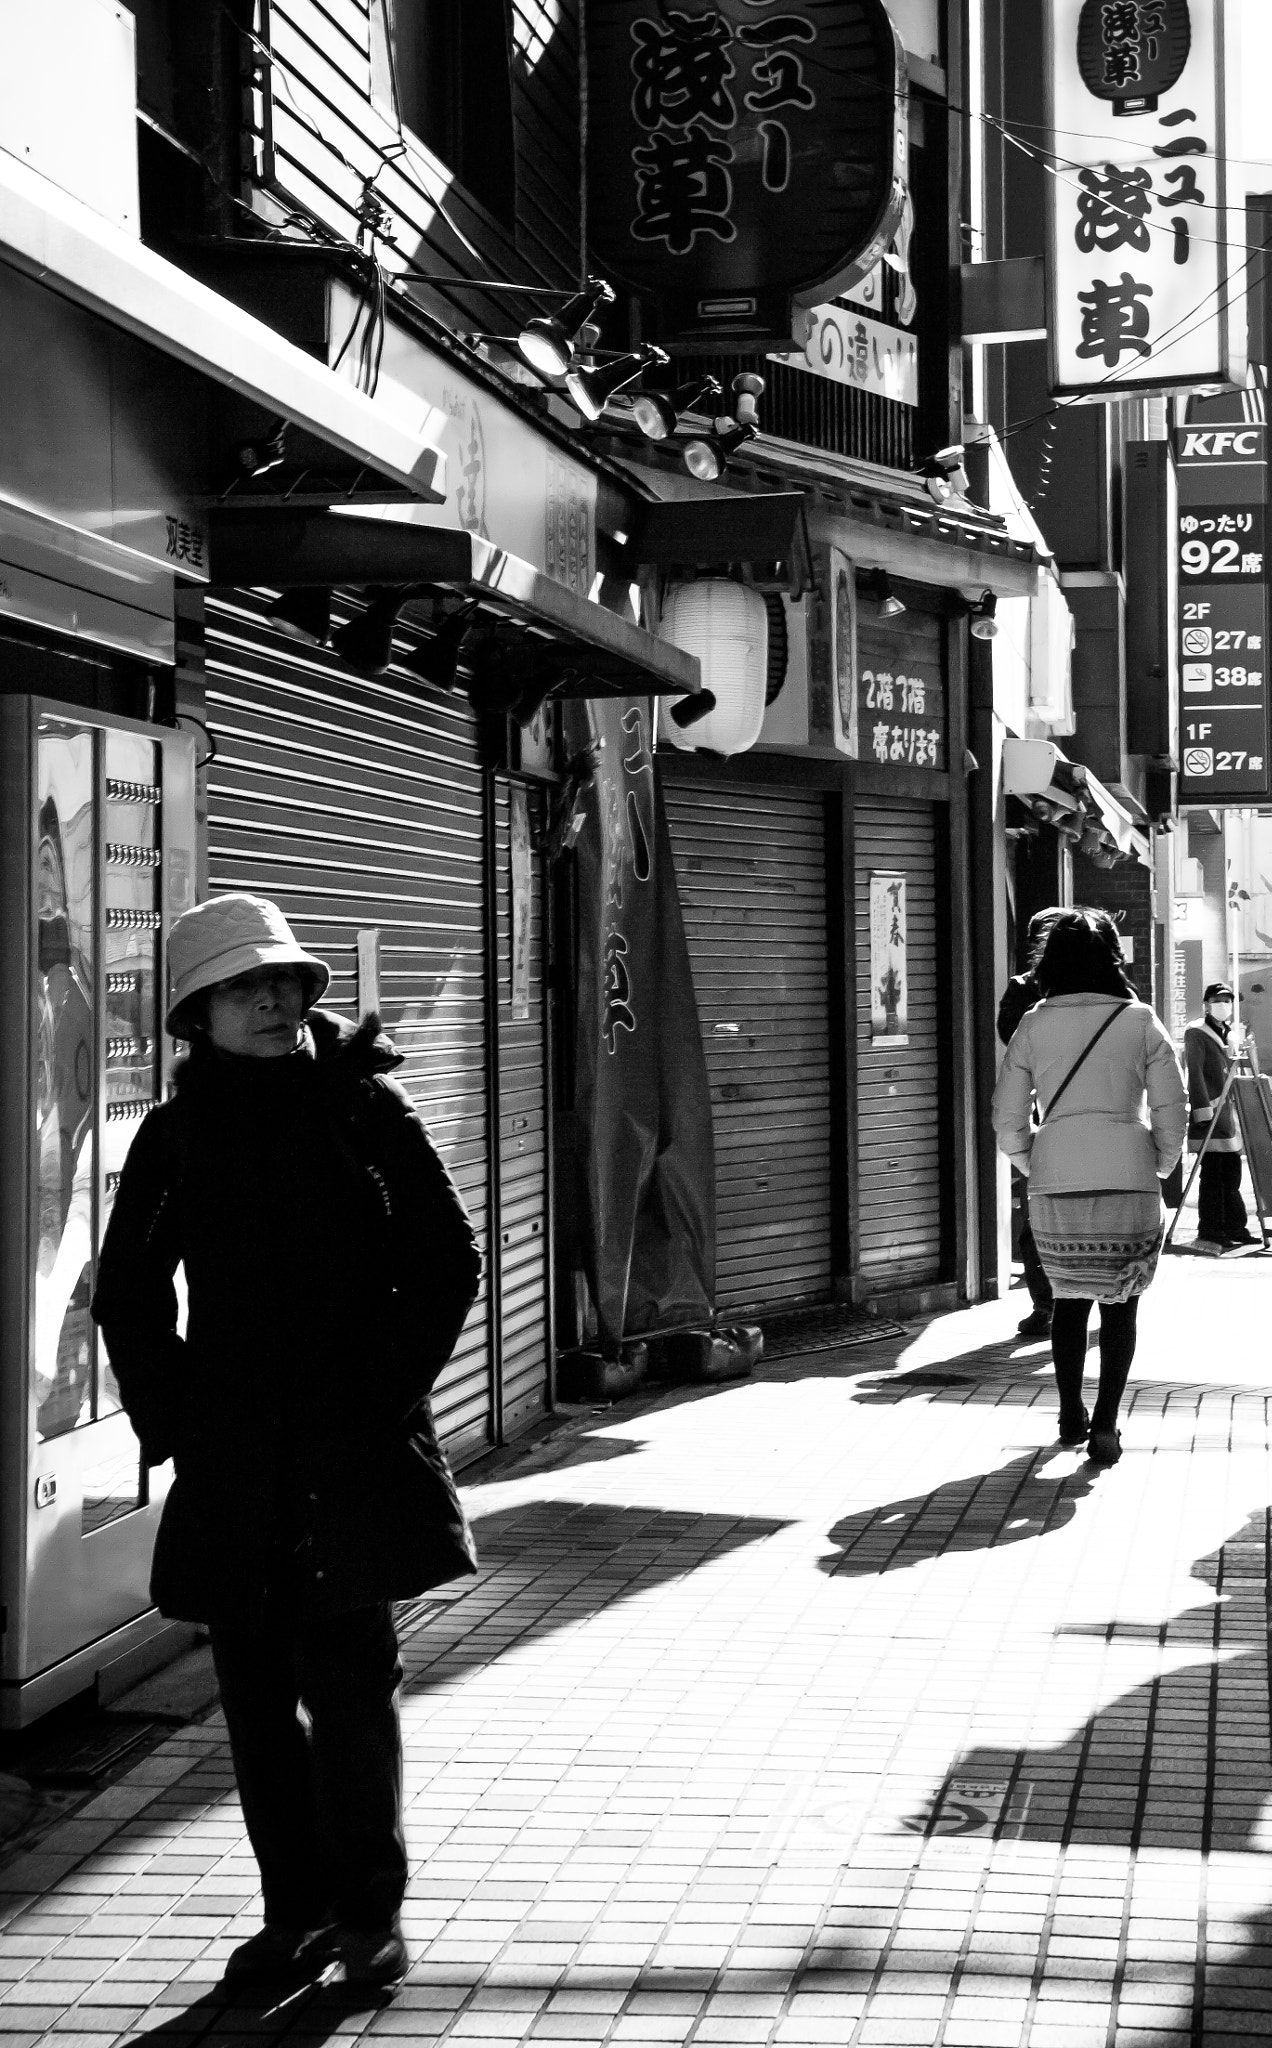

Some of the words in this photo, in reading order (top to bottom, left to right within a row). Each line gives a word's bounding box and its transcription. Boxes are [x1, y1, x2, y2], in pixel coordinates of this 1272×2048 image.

[1152, 108, 1208, 266] ニュー
[1180, 431, 1261, 457] KFC
[1180, 513, 1253, 534] ゆったり
[1180, 538, 1264, 575] 92席
[1182, 602, 1212, 620] 2F
[1214, 630, 1263, 651] 27席
[1214, 666, 1263, 687] 38席
[1186, 722, 1213, 740] 1F
[1215, 751, 1264, 771] 27席
